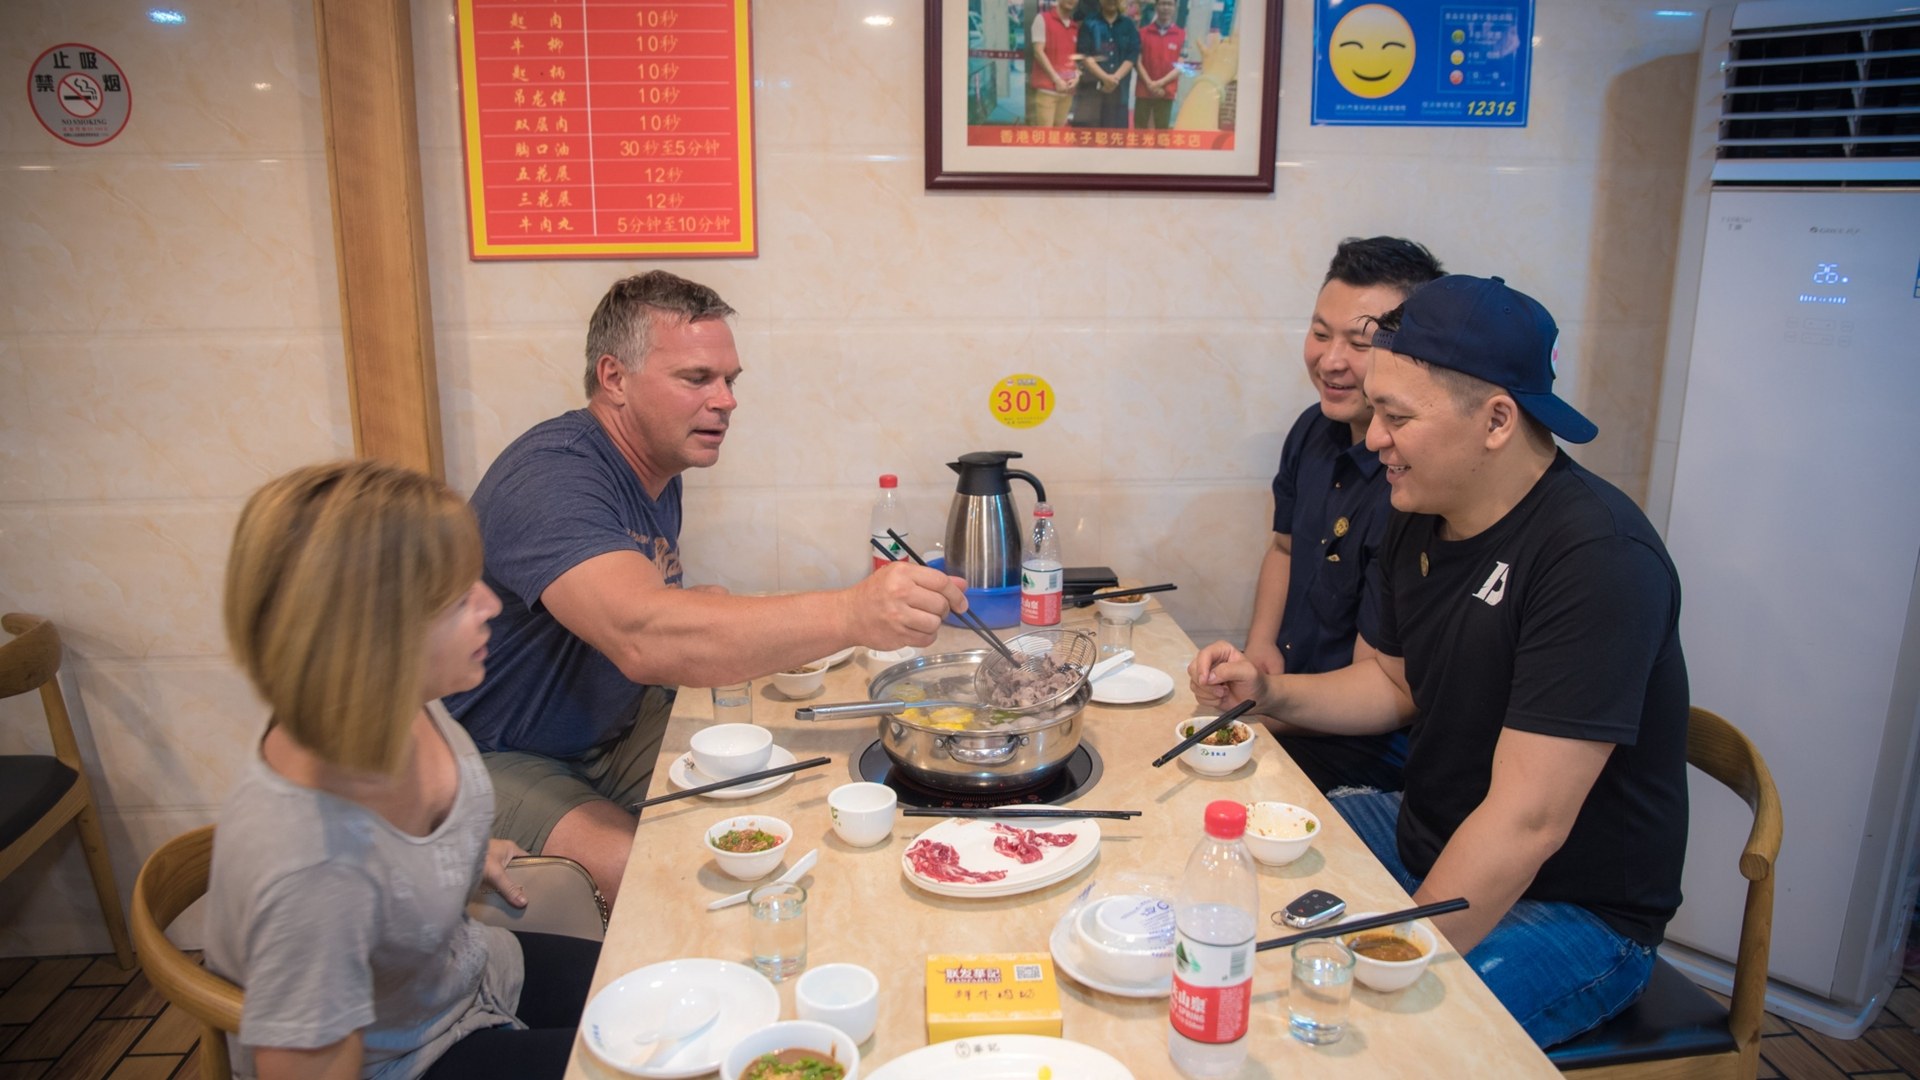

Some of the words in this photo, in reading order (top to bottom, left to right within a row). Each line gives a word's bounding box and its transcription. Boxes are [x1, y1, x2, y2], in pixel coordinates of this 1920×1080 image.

[636, 10, 678, 28] 10秒
[636, 35, 678, 53] 10秒
[637, 62, 679, 80] 10秒
[514, 88, 567, 107] 吊龙伴
[639, 87, 680, 104] 10秒
[1467, 101, 1516, 117] 12315
[514, 116, 568, 133] 双层肉
[640, 114, 681, 132] 10秒
[514, 142, 570, 158] 胸口油
[620, 138, 721, 156] 30秒至5分钟
[644, 167, 684, 183] 12秒
[645, 192, 685, 209] 12秒
[518, 216, 574, 233] 牛肉丸
[617, 215, 731, 233] 5分钟至10分钟
[997, 389, 1046, 413] 301
